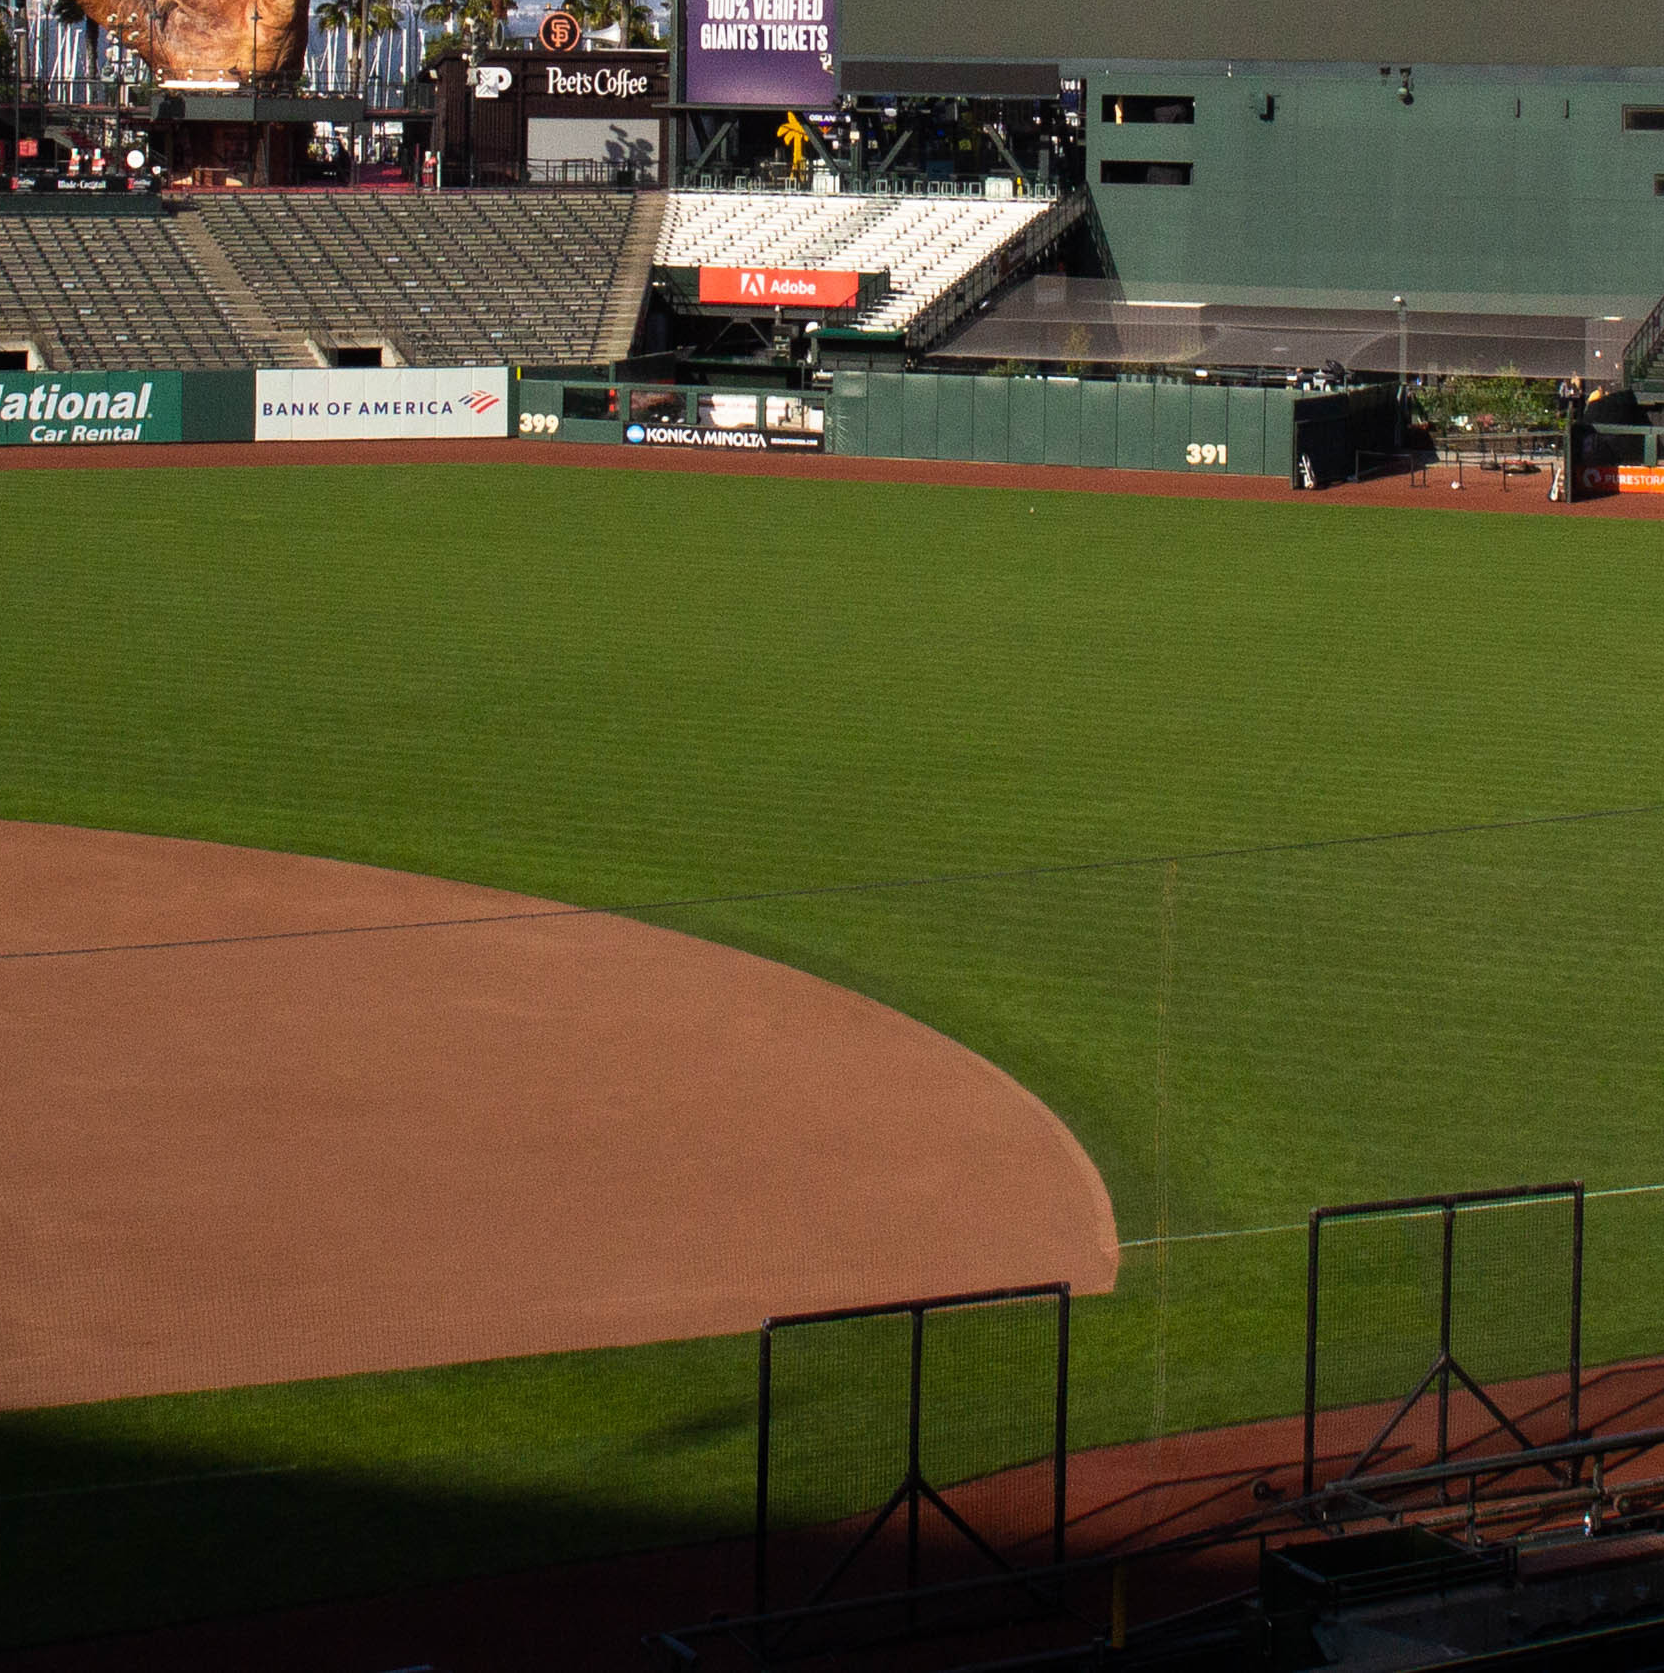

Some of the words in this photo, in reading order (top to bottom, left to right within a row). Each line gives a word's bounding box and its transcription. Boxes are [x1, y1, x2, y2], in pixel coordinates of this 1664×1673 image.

[700, 24, 758, 50] GIANTS
[761, 24, 829, 51] TICKETS
[545, 67, 592, 95] Peet's
[594, 68, 647, 98] Coffee
[770, 279, 816, 297] Adobe
[262, 400, 320, 417] BANK
[326, 401, 352, 417] OF
[357, 399, 454, 417] AMERICA
[30, 425, 67, 443] Car
[70, 424, 141, 443] Rental
[519, 413, 559, 434] 399
[646, 427, 702, 445] KONICA
[703, 431, 767, 448] MINOLTA
[1185, 442, 1227, 465] 391
